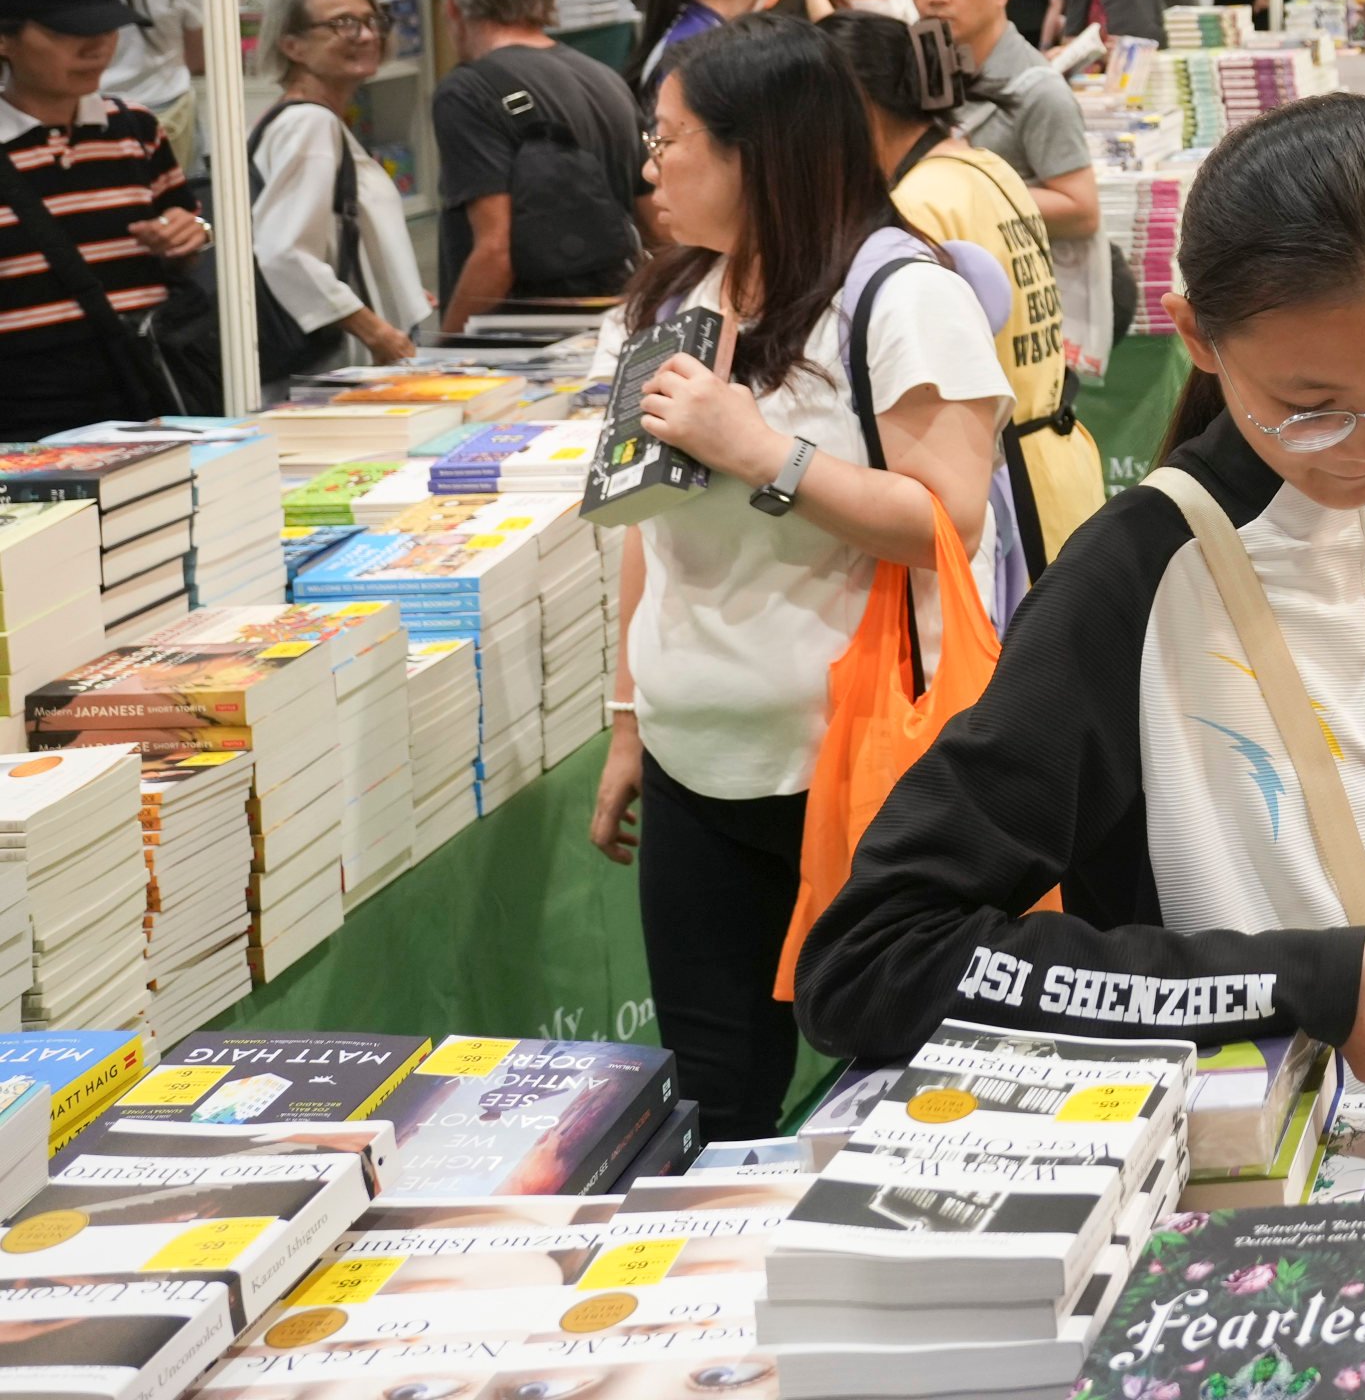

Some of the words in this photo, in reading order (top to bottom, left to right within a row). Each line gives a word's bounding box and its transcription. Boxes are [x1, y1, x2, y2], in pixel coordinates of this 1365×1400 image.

[34, 706, 72, 718] Modern
[74, 704, 144, 718] JAPANESE
[147, 705, 173, 714] SHORT
[175, 705, 206, 714] STORIES
[956, 946, 1033, 1006] QSI
[1038, 966, 1277, 1028] SHENZHEN
[184, 1048, 283, 1064] HAIG
[286, 1051, 392, 1065] MATT
[922, 1053, 1051, 1080] Ishiguro
[85, 1064, 119, 1096] HAIG
[1064, 1069, 1168, 1085] Kazuo
[480, 1093, 540, 1107] SEE
[417, 1113, 559, 1130] CANNOT
[444, 1134, 498, 1148] WE
[873, 1128, 1014, 1154] Orphans
[1033, 1139, 1111, 1157] Were
[220, 1163, 335, 1180] Kazuo
[402, 1155, 504, 1171] LIGHT
[63, 1163, 211, 1186] Ishiguro
[610, 1216, 750, 1237] Ishiguro
[333, 1232, 478, 1255] Ishiguro
[490, 1231, 604, 1249] Kazuo
[140, 1280, 211, 1304] The
